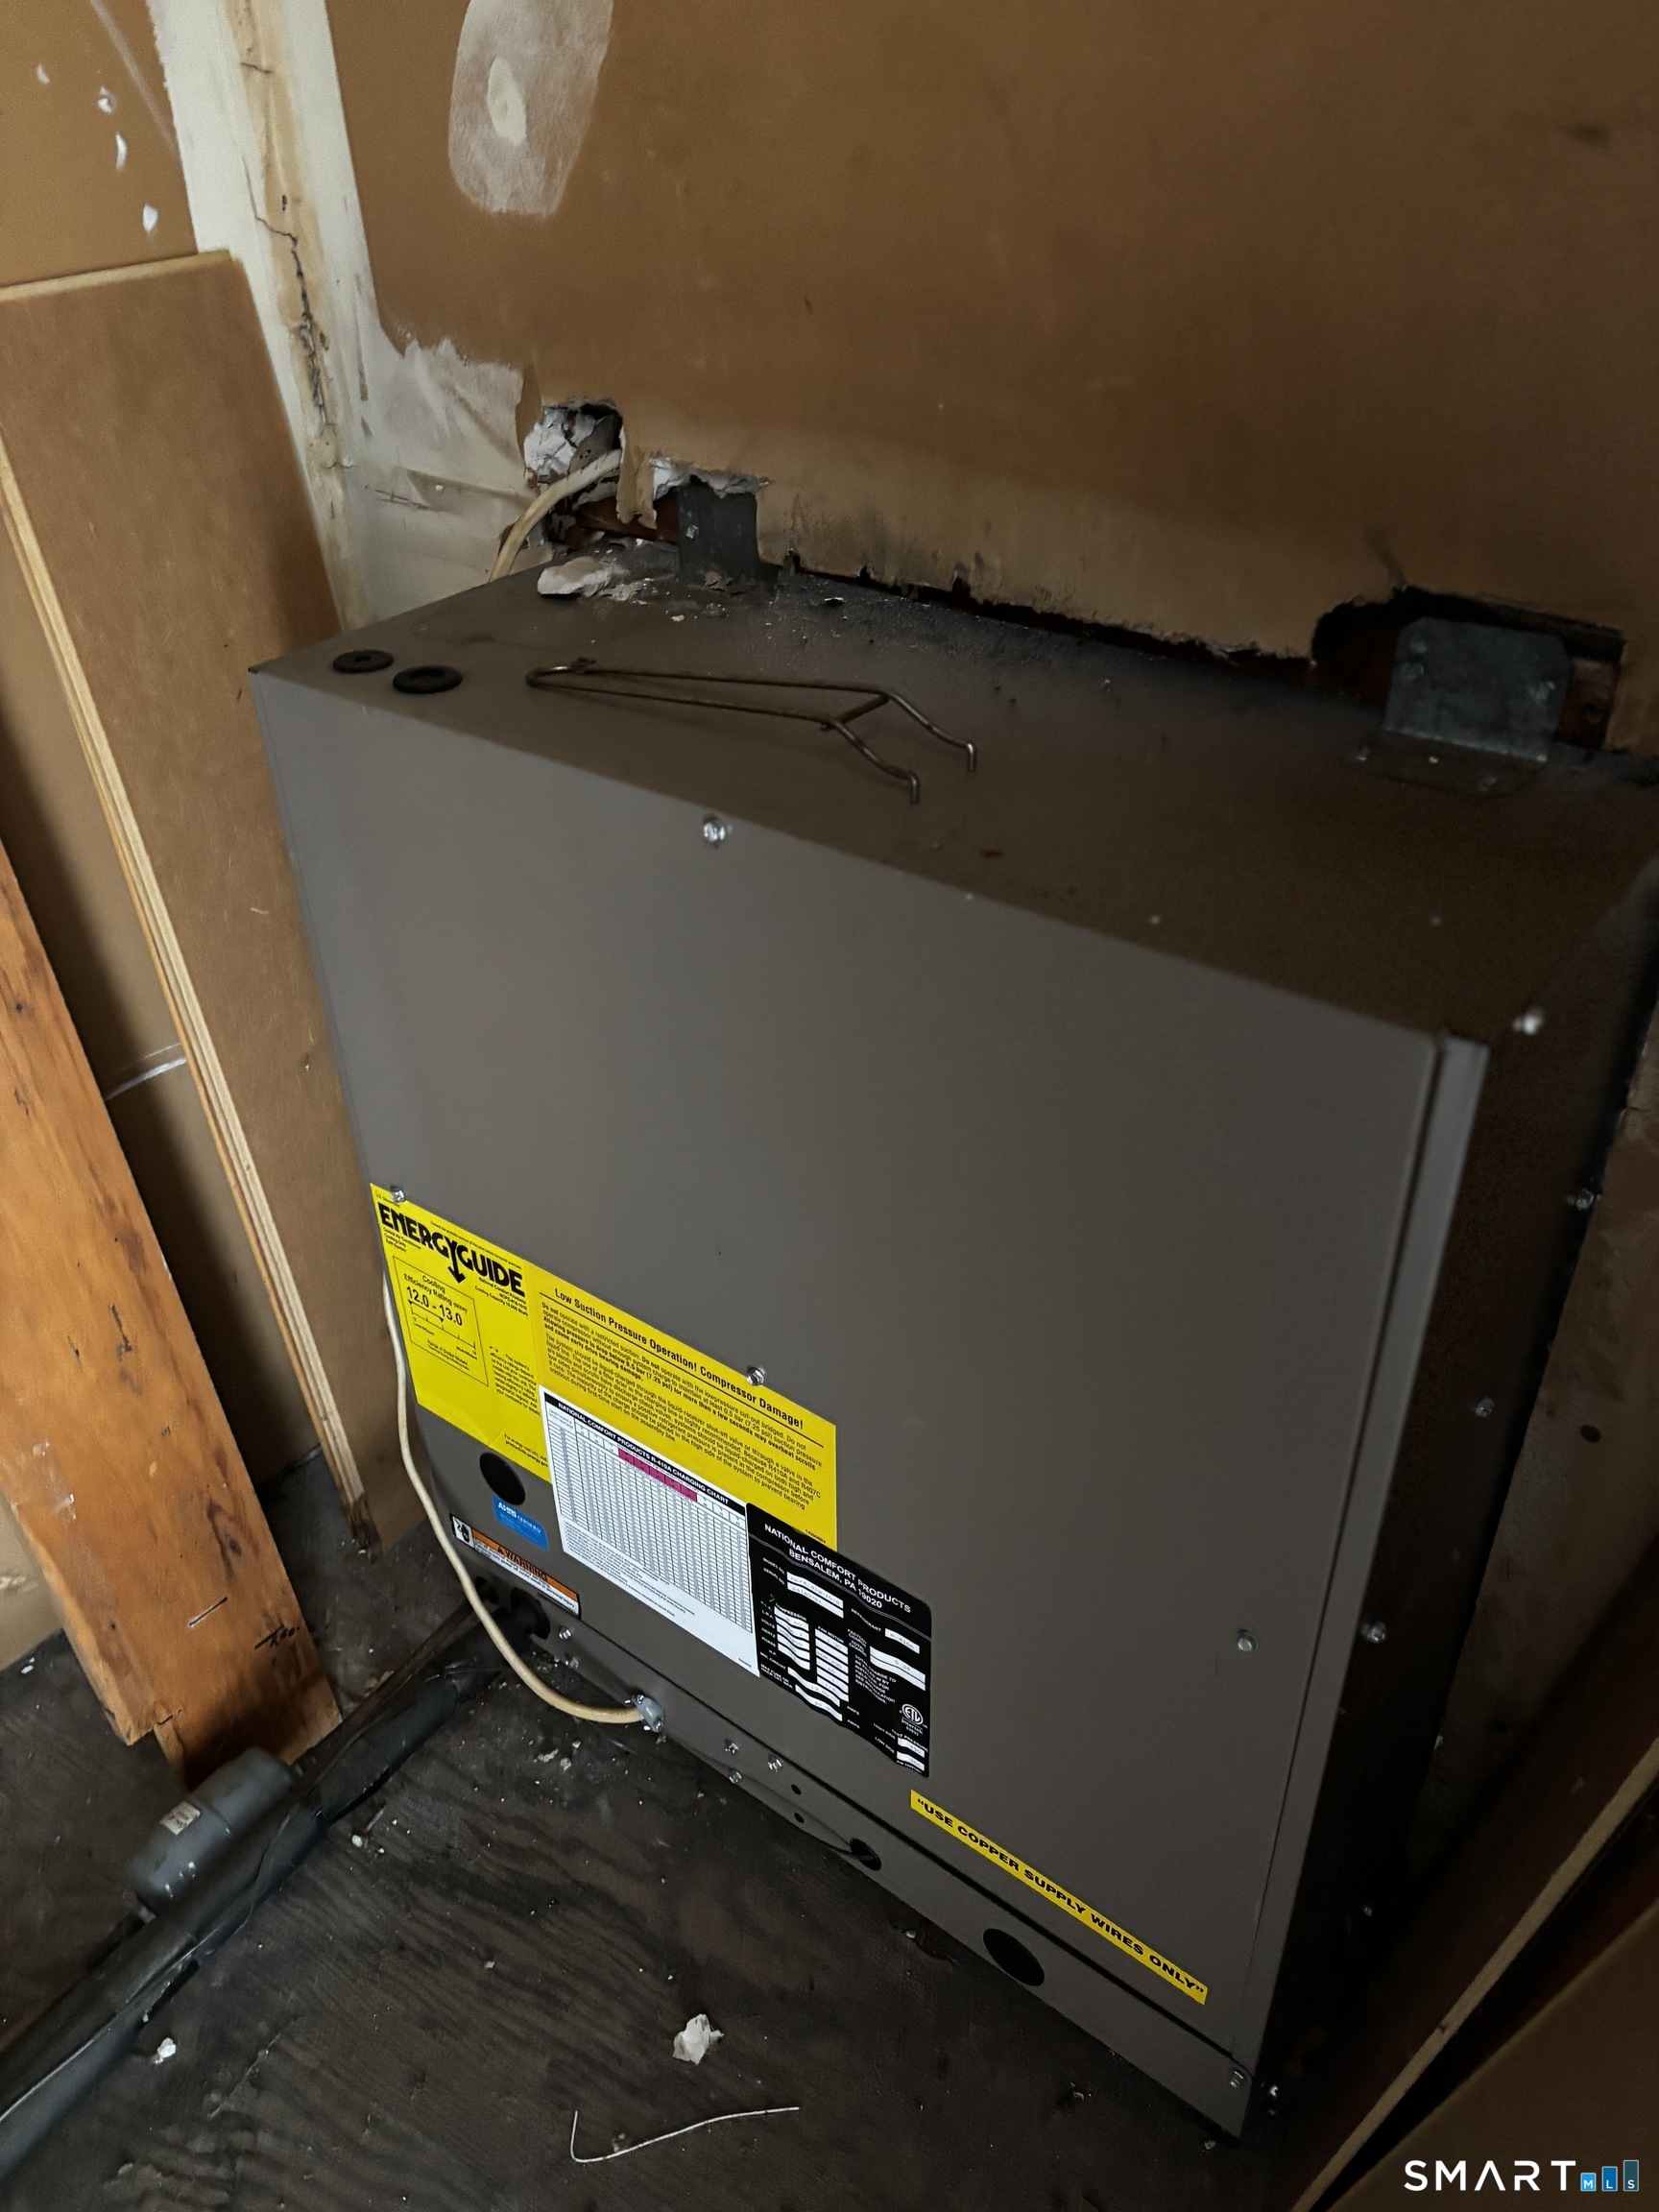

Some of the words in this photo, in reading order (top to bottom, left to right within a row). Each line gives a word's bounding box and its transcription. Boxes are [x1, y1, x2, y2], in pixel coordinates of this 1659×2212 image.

[377, 1202, 526, 1298] ENERGYGUIDE
[403, 1273, 434, 1297] Efficiency
[433, 1289, 454, 1308] Rating
[422, 1275, 446, 1294] Cooling
[406, 1286, 429, 1308] 12.0
[439, 1304, 463, 1327] 13.0
[555, 1288, 572, 1305] Low
[574, 1299, 606, 1323] Suction
[609, 1317, 647, 1345] Pressure
[649, 1339, 697, 1373] Operation!
[700, 1366, 757, 1405] Compressor
[759, 1398, 803, 1429] Damage!
[558, 1403, 587, 1424] NATIONAL
[588, 1420, 616, 1438] COMFORT
[617, 1435, 650, 1459] PRODUCTS
[673, 1469, 706, 1491] CHARGING
[707, 1487, 730, 1504] CHART
[764, 1524, 808, 1555] NATIONAL
[810, 1551, 856, 1580] COMFORT
[857, 1578, 911, 1613] PRODUCTS
[789, 1548, 842, 1583] BENSALEM,
[844, 1579, 857, 1593] PA
[857, 1588, 882, 1609] 19020
[958, 1825, 1020, 1870] COPPER
[1024, 1870, 1086, 1914] SUPPLY
[1091, 1914, 1143, 1955] WIRES
